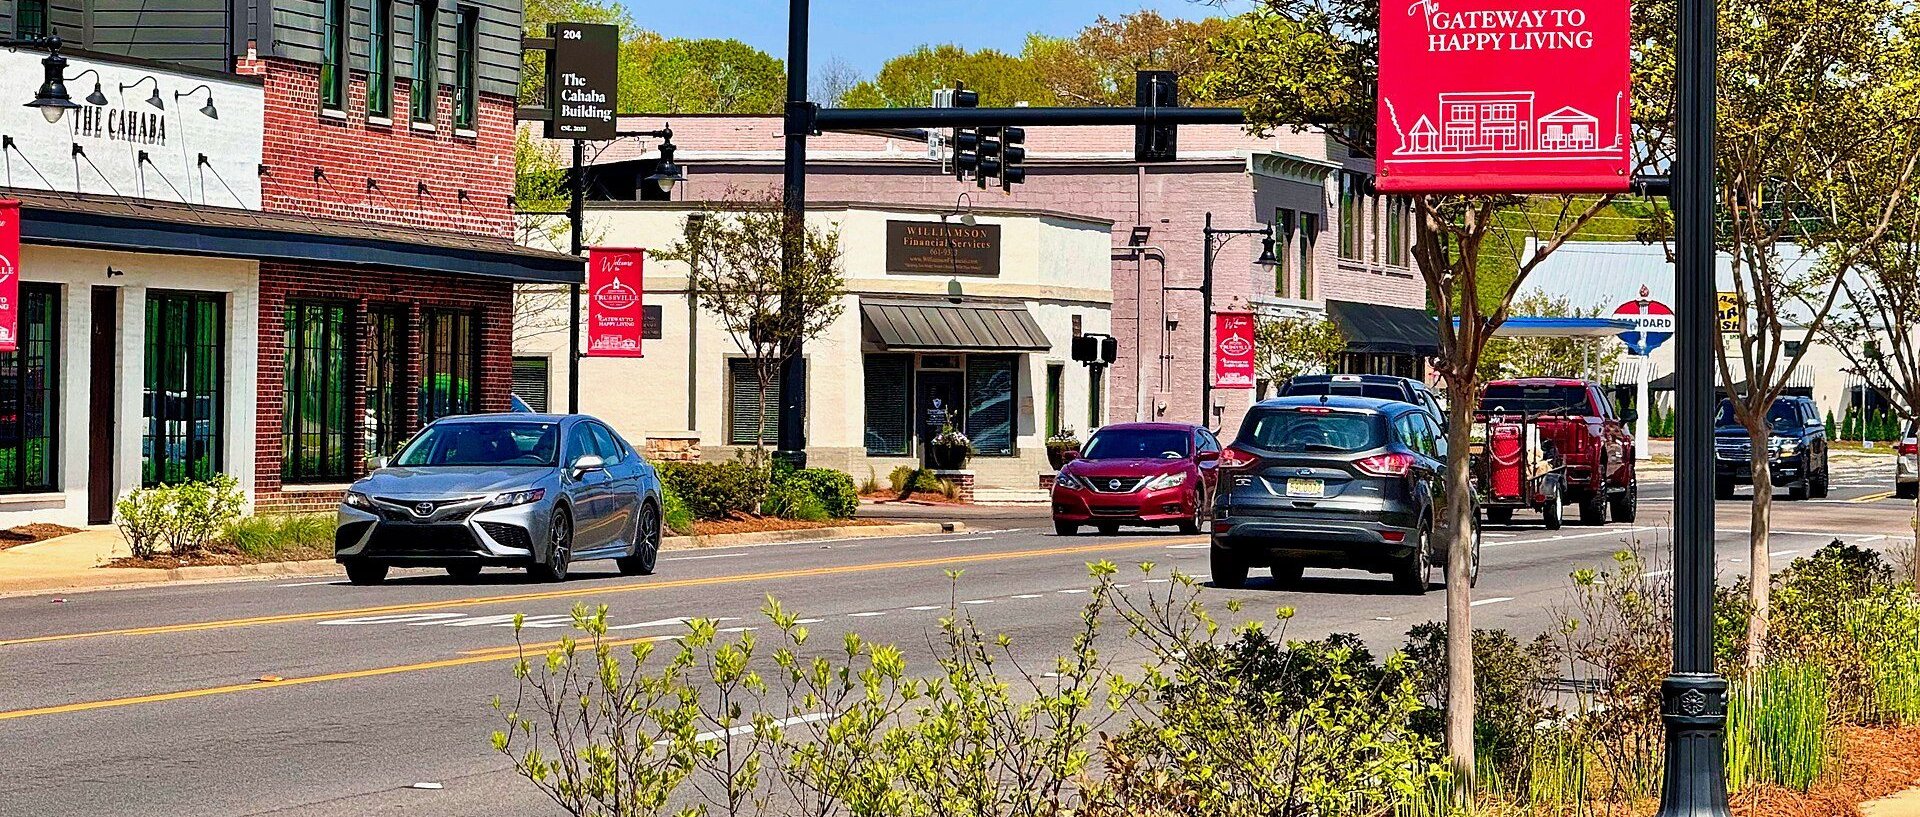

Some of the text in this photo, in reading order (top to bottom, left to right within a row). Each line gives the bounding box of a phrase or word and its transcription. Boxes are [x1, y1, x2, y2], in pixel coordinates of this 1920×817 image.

[1408, 0, 1439, 32] The
[1432, 9, 1586, 30] GATEWAY TO
[563, 30, 582, 40] 204
[1428, 31, 1594, 52] HAPPY LIVING
[562, 73, 586, 86] The
[561, 89, 606, 103] Cahaba
[561, 105, 613, 122] Building
[74, 105, 166, 142] THE CAHABA
[906, 226, 988, 238] WILLIAMSON
[903, 236, 991, 249] Financial Services
[1617, 318, 1671, 328] NDARD
